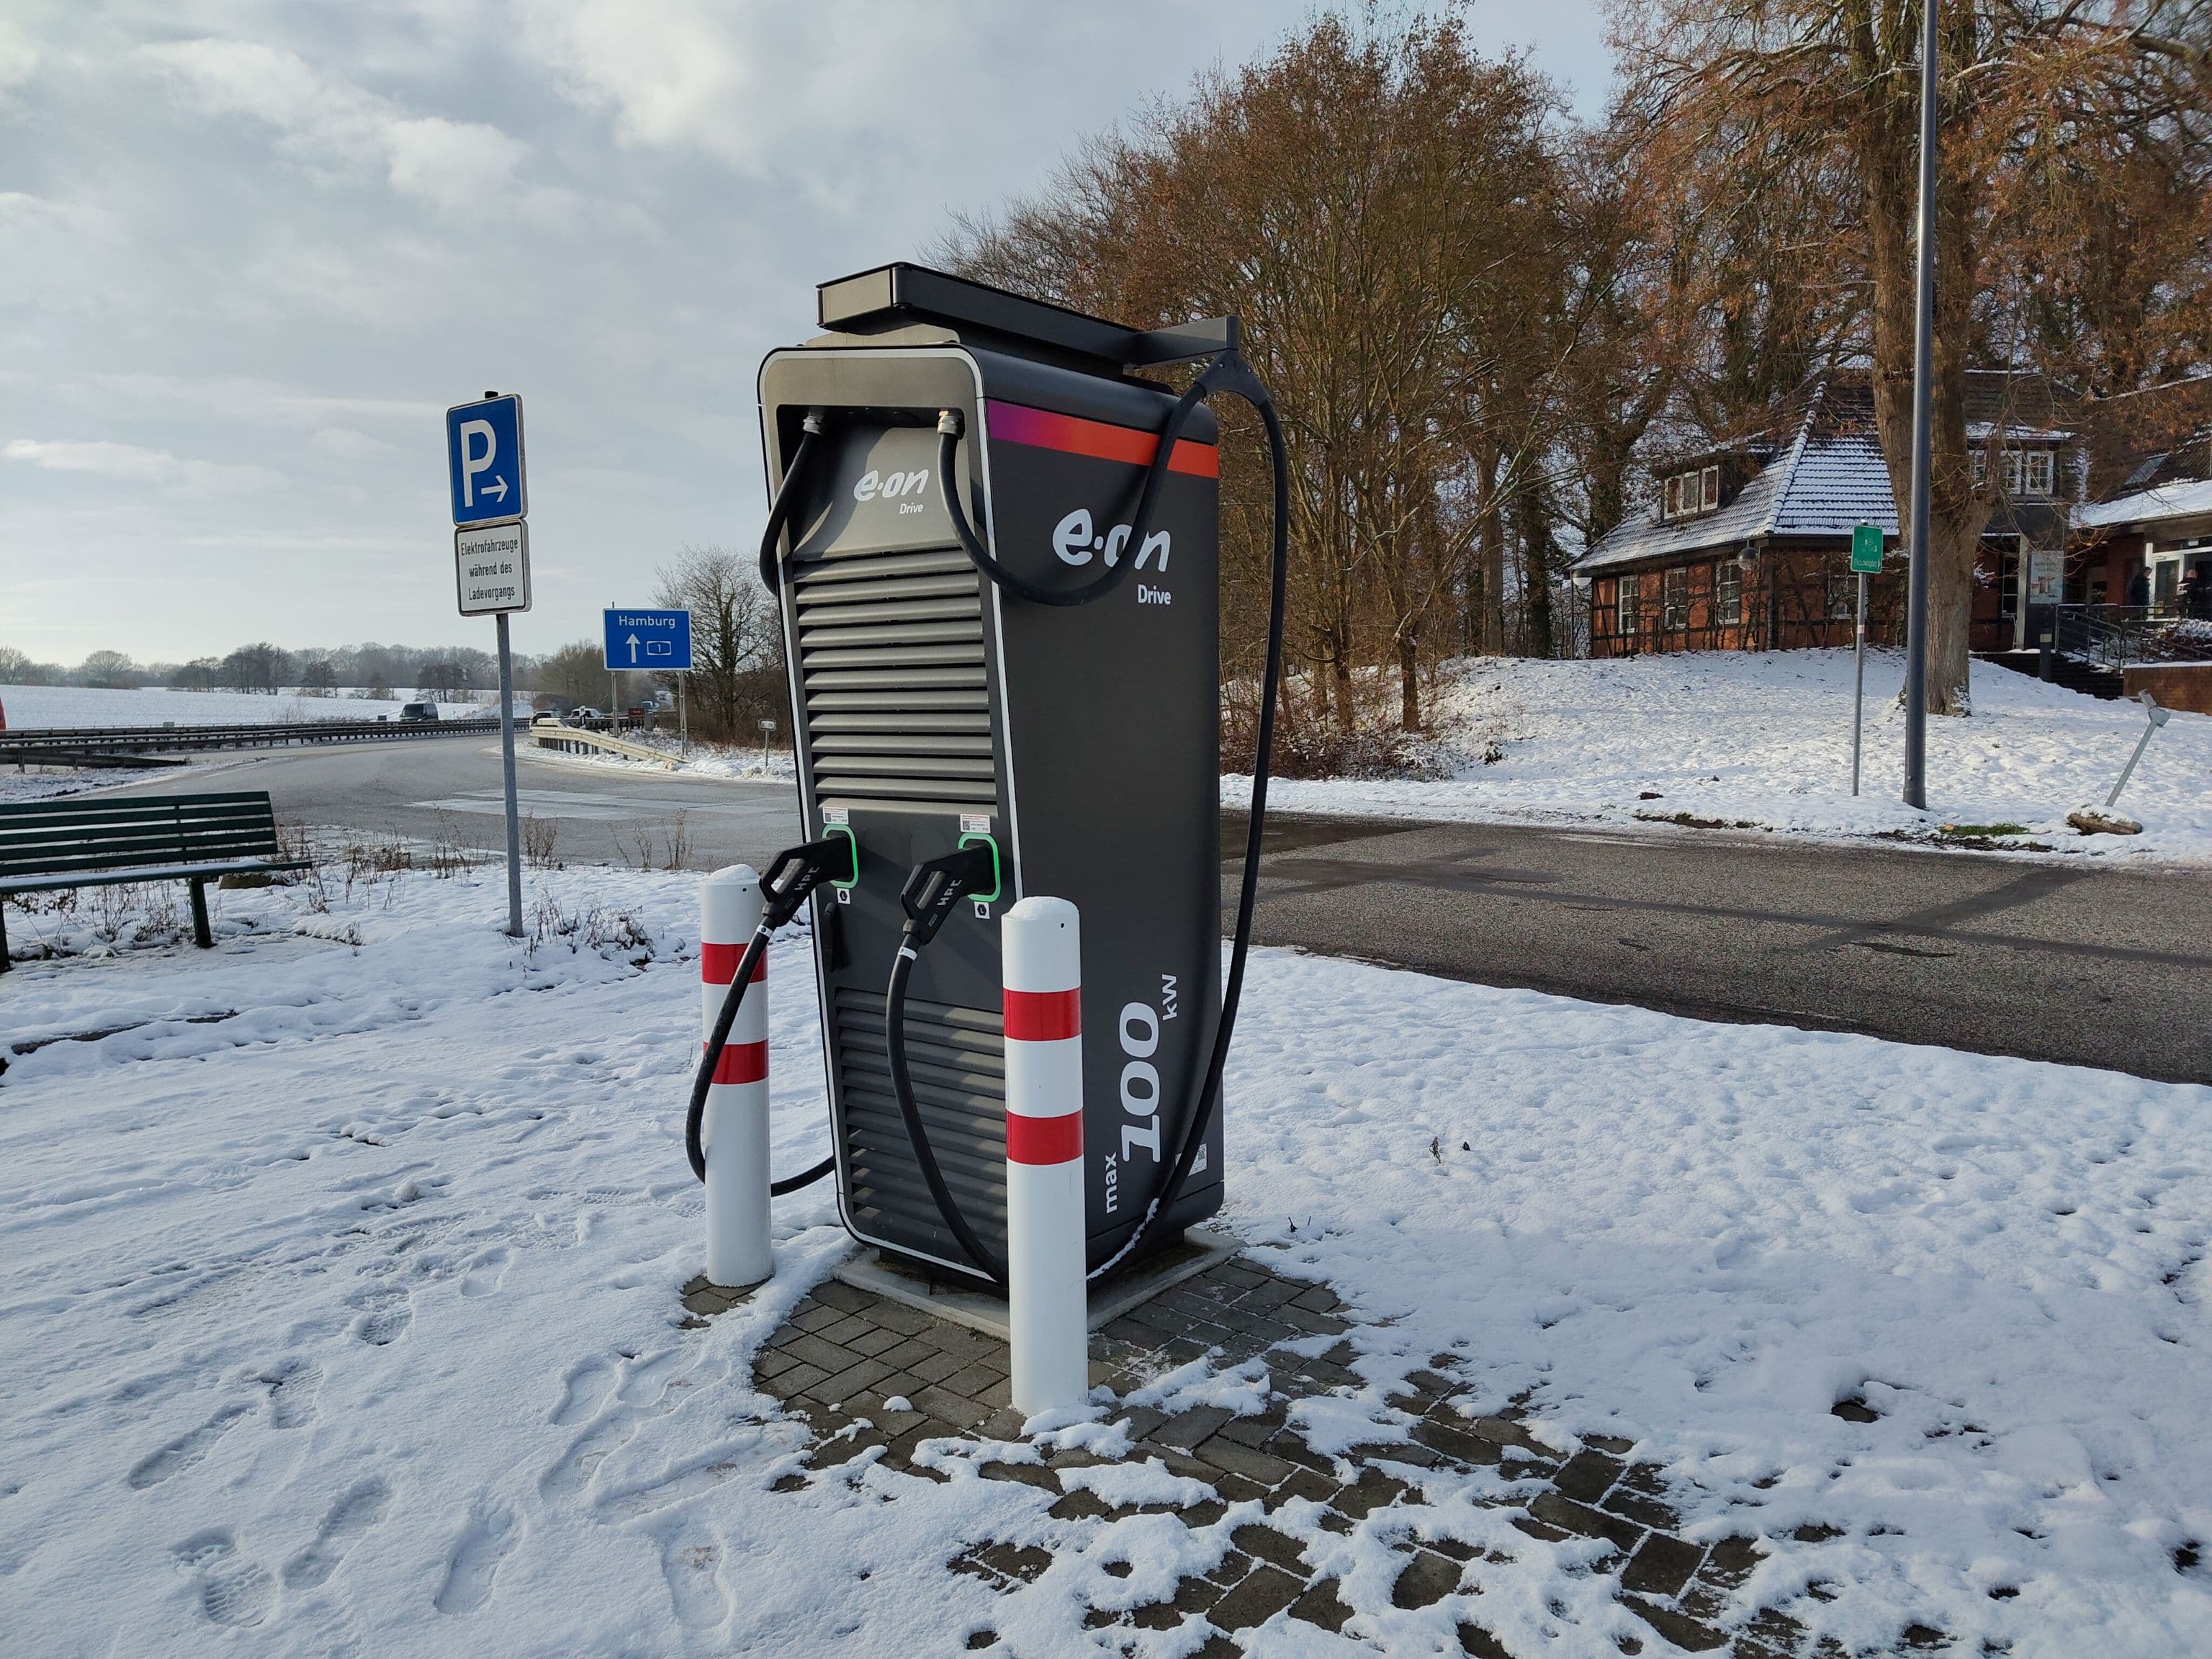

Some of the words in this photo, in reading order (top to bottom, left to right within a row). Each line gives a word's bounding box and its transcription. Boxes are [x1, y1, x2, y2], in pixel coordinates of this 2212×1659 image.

[459, 419, 497, 508] P
[899, 501, 924, 514] Drive
[461, 539, 518, 556] Elektrofahrzeuge
[469, 561, 497, 577] während
[500, 560, 513, 575] des
[468, 586, 516, 601] Ladevorgangs
[1138, 584, 1172, 606] Drive
[619, 615, 675, 629] Hamburg
[657, 644, 662, 653] 1
[793, 866, 820, 891] HPC
[936, 879, 963, 906] HPC
[1105, 1151, 1118, 1214] max
[1119, 1002, 1161, 1163] 100
[1161, 974, 1178, 1021] kW
